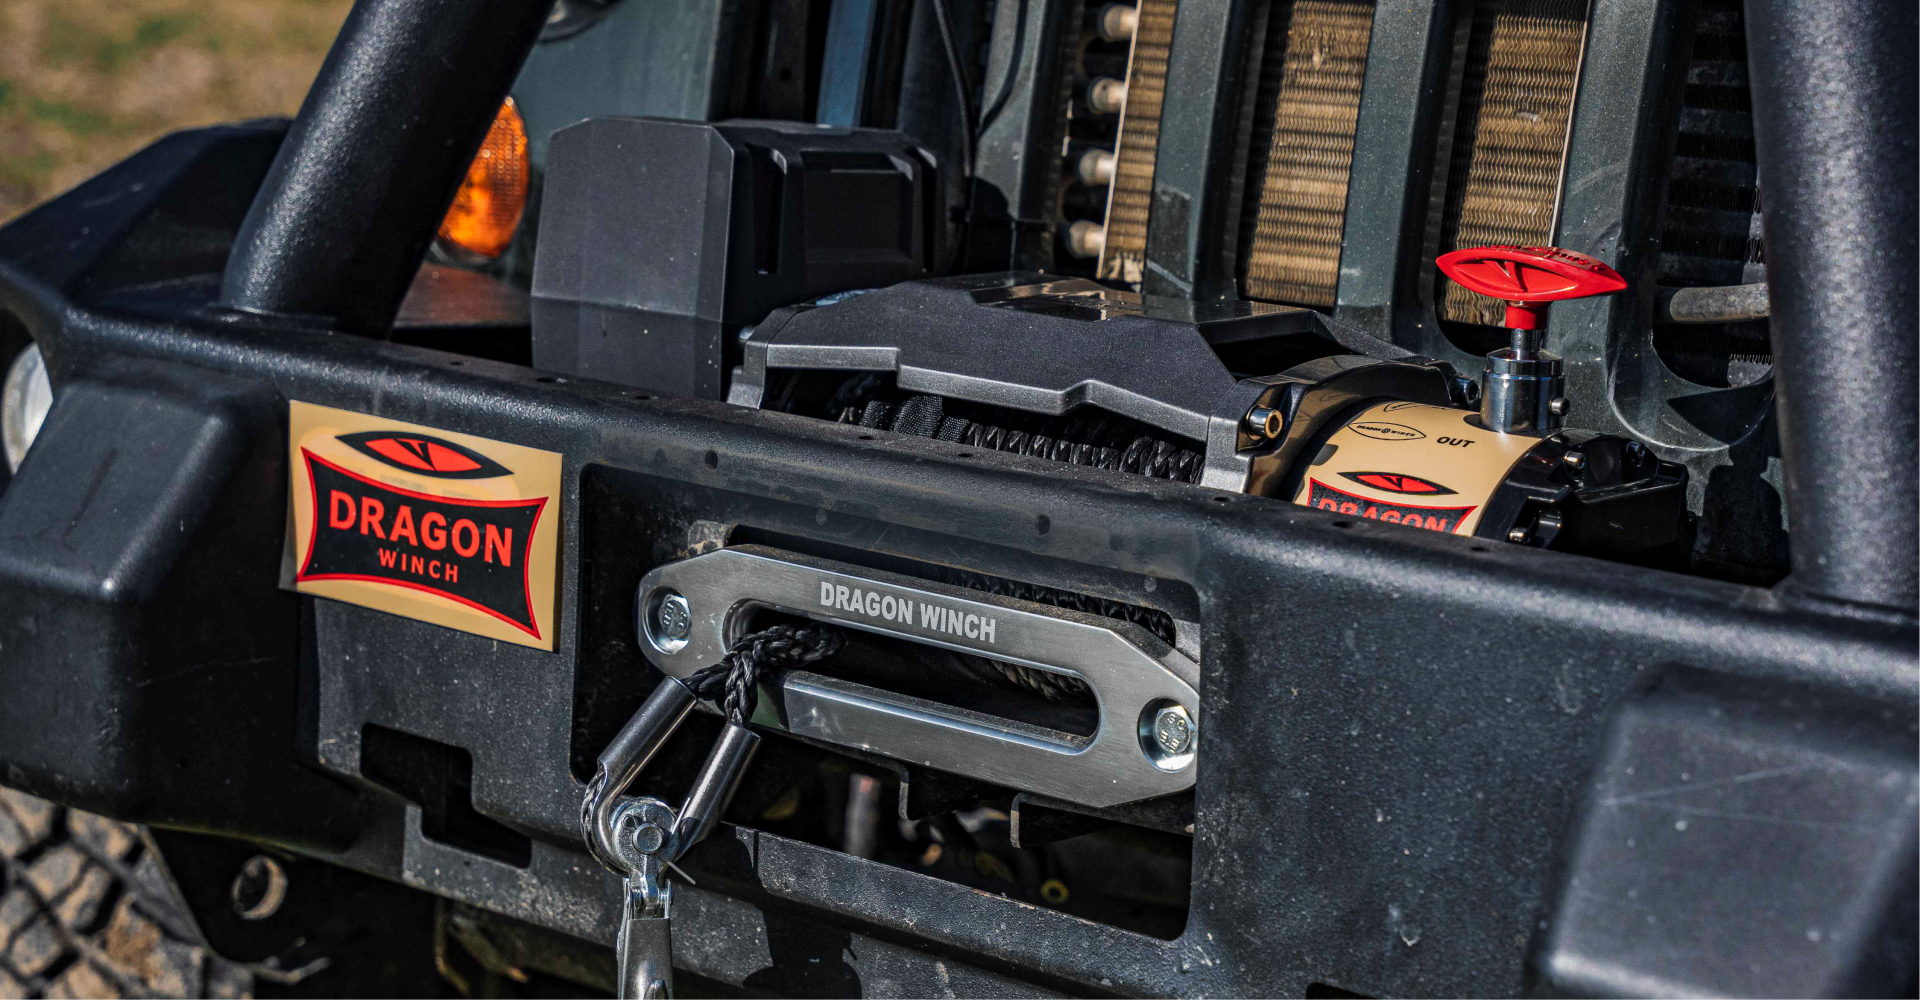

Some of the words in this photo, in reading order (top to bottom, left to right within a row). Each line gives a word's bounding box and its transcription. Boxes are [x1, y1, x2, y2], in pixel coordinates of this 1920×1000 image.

[1436, 436, 1476, 448] OUT
[328, 489, 513, 568] DRAGON
[378, 547, 459, 584] WINCH
[820, 581, 914, 625] DRAGON
[920, 602, 996, 644] WINCH
